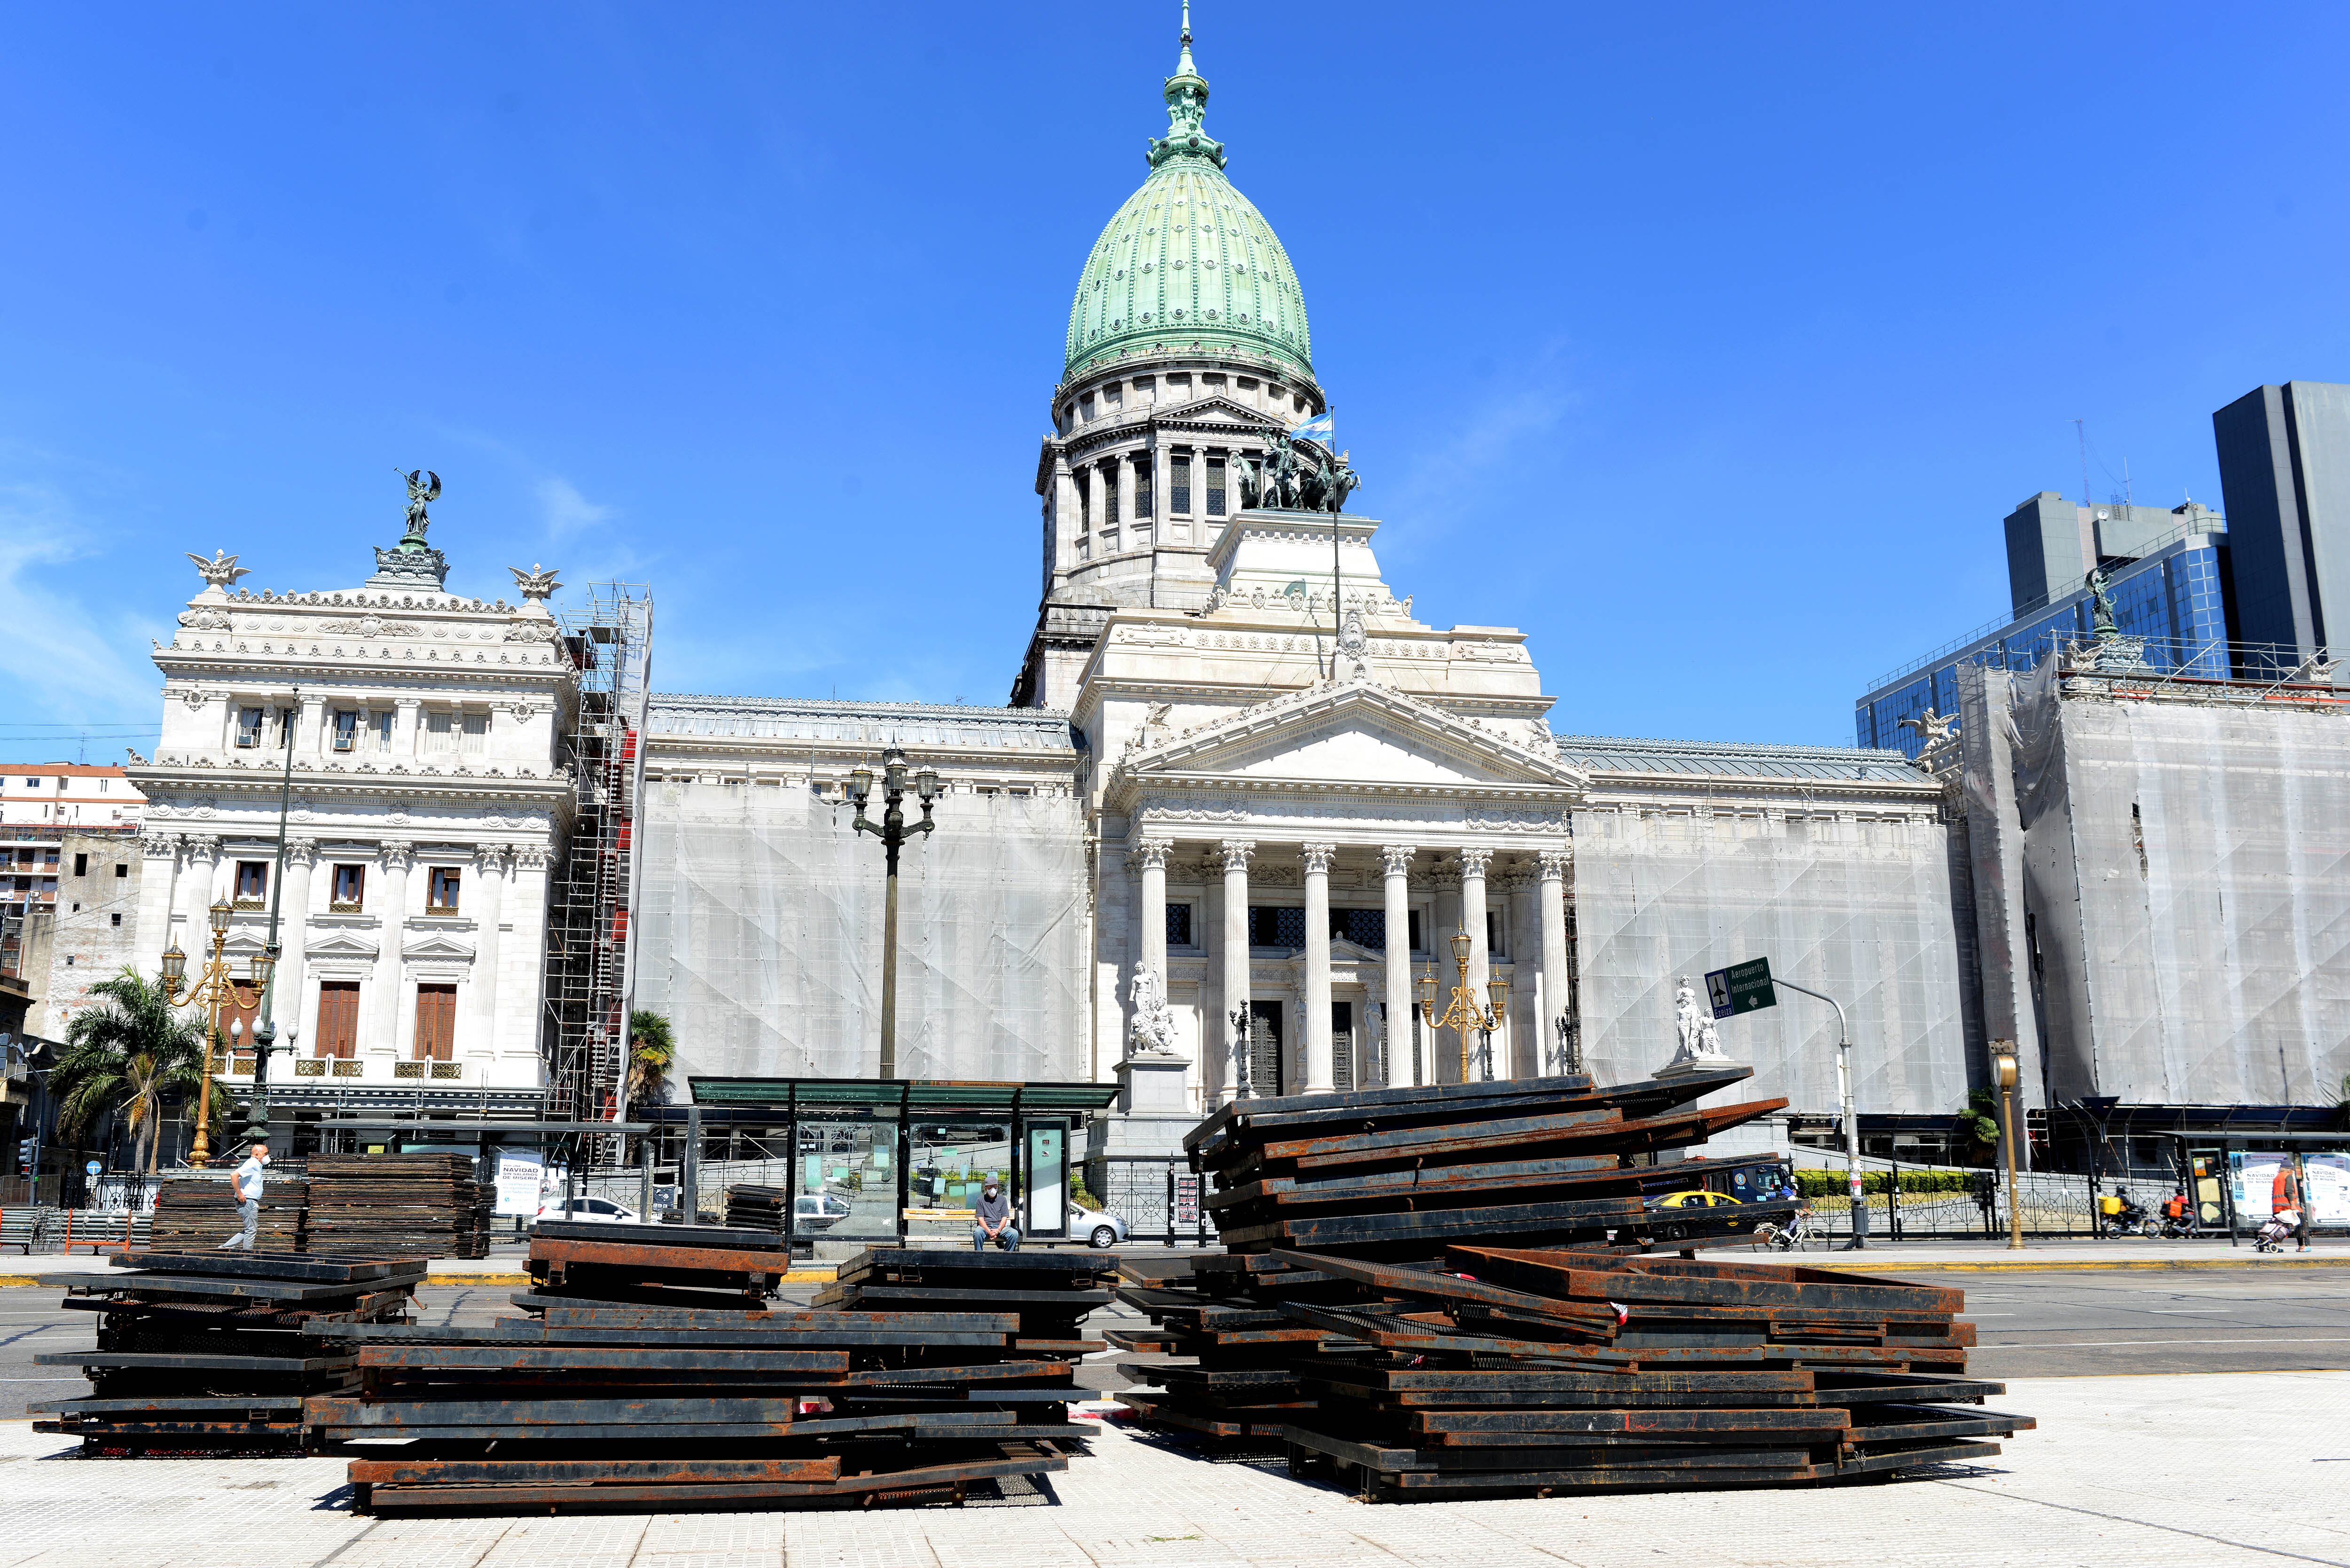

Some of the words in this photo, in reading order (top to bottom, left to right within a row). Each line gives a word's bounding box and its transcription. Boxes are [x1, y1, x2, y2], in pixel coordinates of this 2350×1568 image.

[1731, 963, 1764, 980] Aeropuerto
[1731, 975, 1769, 994] Internacional
[1715, 1007, 1732, 1018] Ezeiza
[2233, 1155, 2242, 1168] LA
